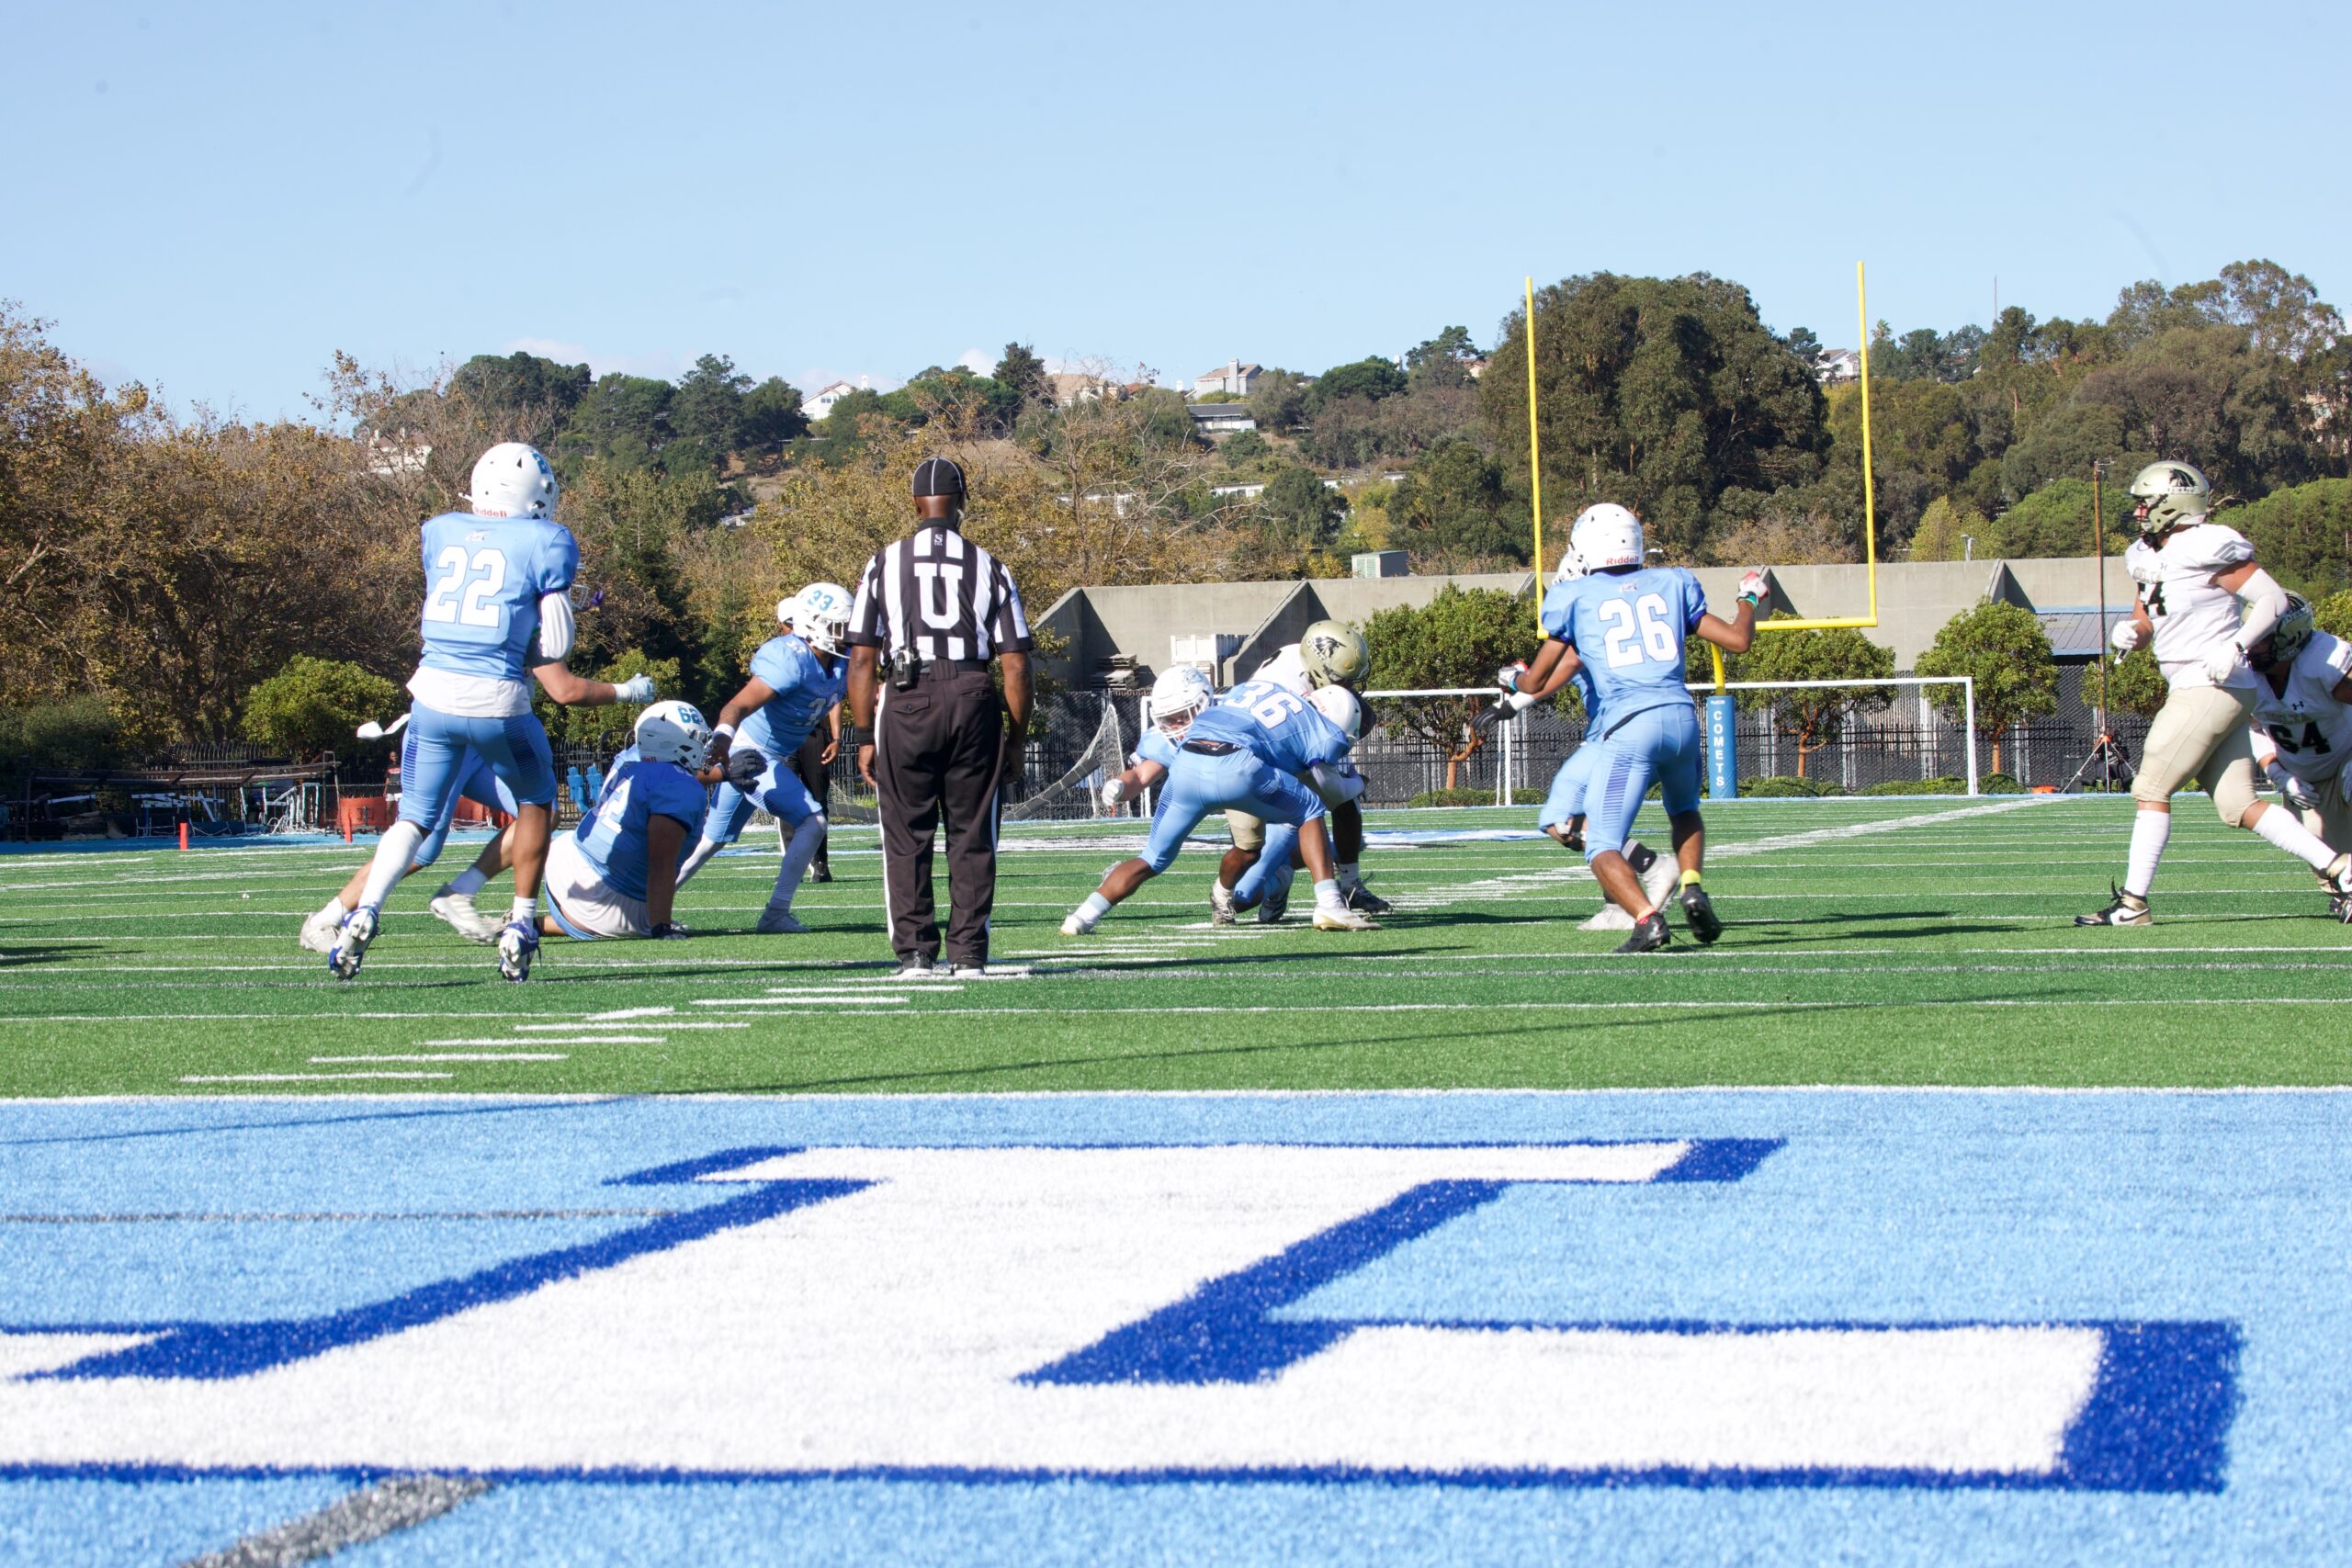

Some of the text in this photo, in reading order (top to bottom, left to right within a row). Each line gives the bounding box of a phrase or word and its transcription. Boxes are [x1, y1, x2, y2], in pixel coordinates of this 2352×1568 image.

[424, 545, 507, 628] 22
[1606, 555, 1640, 566] Riddell
[807, 589, 834, 612] 33
[913, 562, 964, 629] U
[1598, 592, 1679, 669] 26
[677, 705, 703, 725] 62
[1223, 680, 1304, 730] 36
[1713, 710, 1725, 787] COMETS
